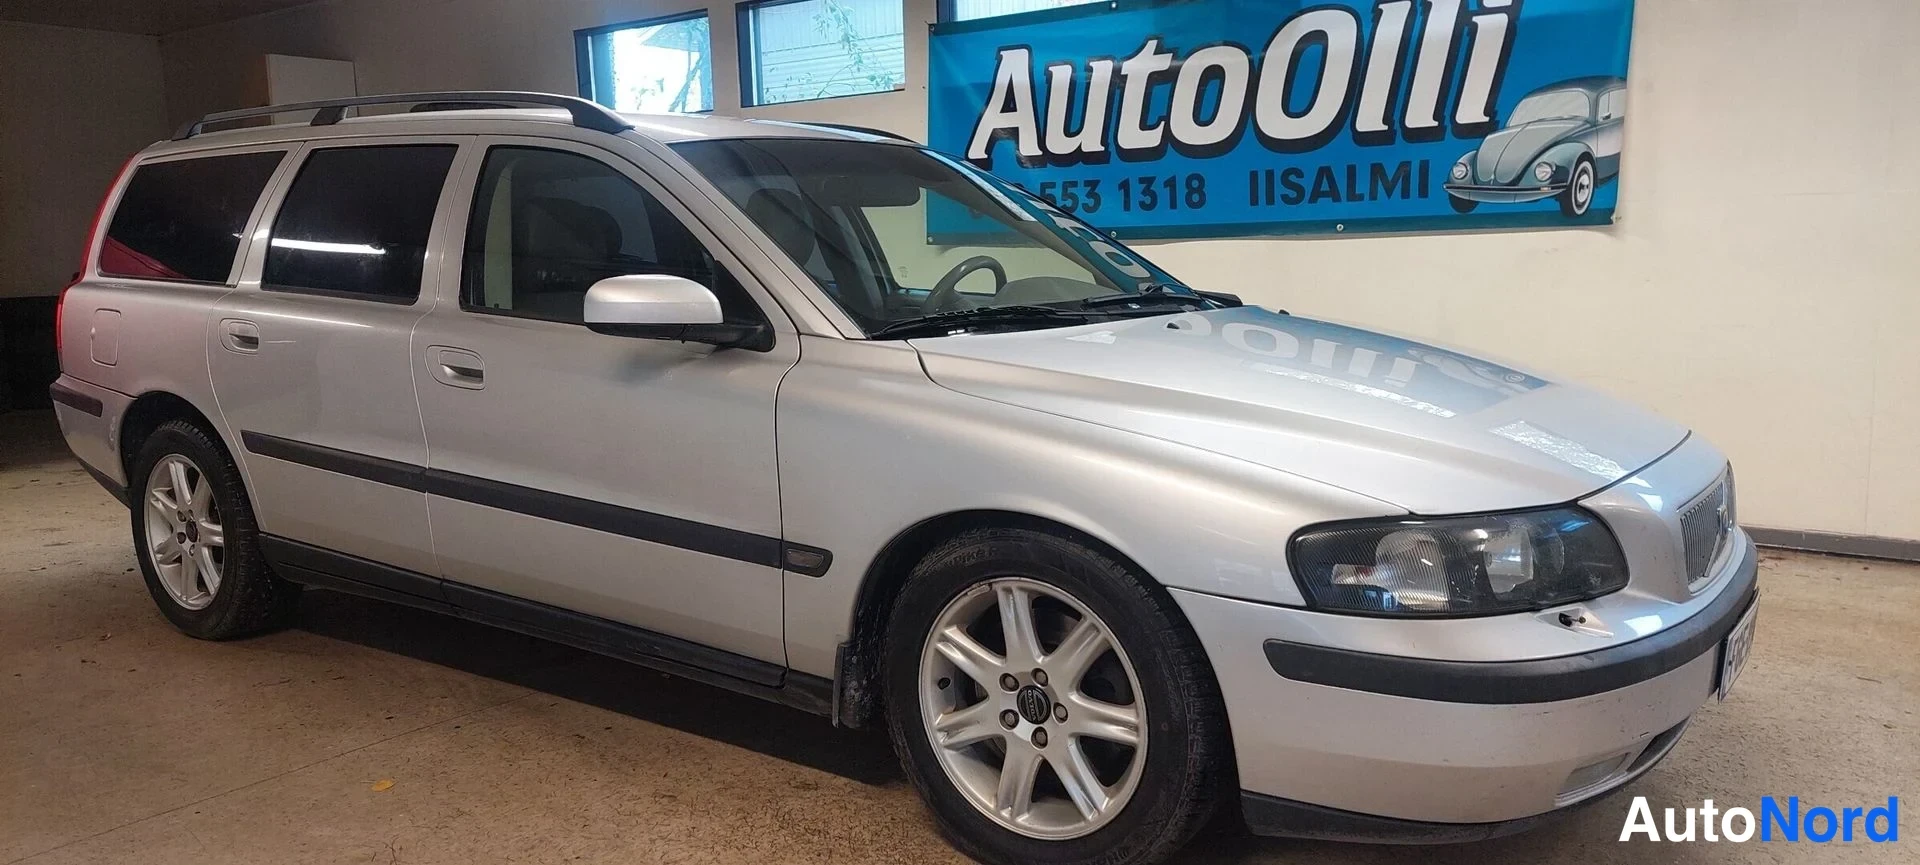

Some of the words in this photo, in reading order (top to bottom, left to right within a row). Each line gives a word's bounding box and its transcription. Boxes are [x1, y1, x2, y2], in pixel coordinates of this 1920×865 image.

[968, 0, 1514, 160] AutoOlli
[1117, 173, 1207, 212] 1318
[1249, 159, 1430, 207] IISALMI
